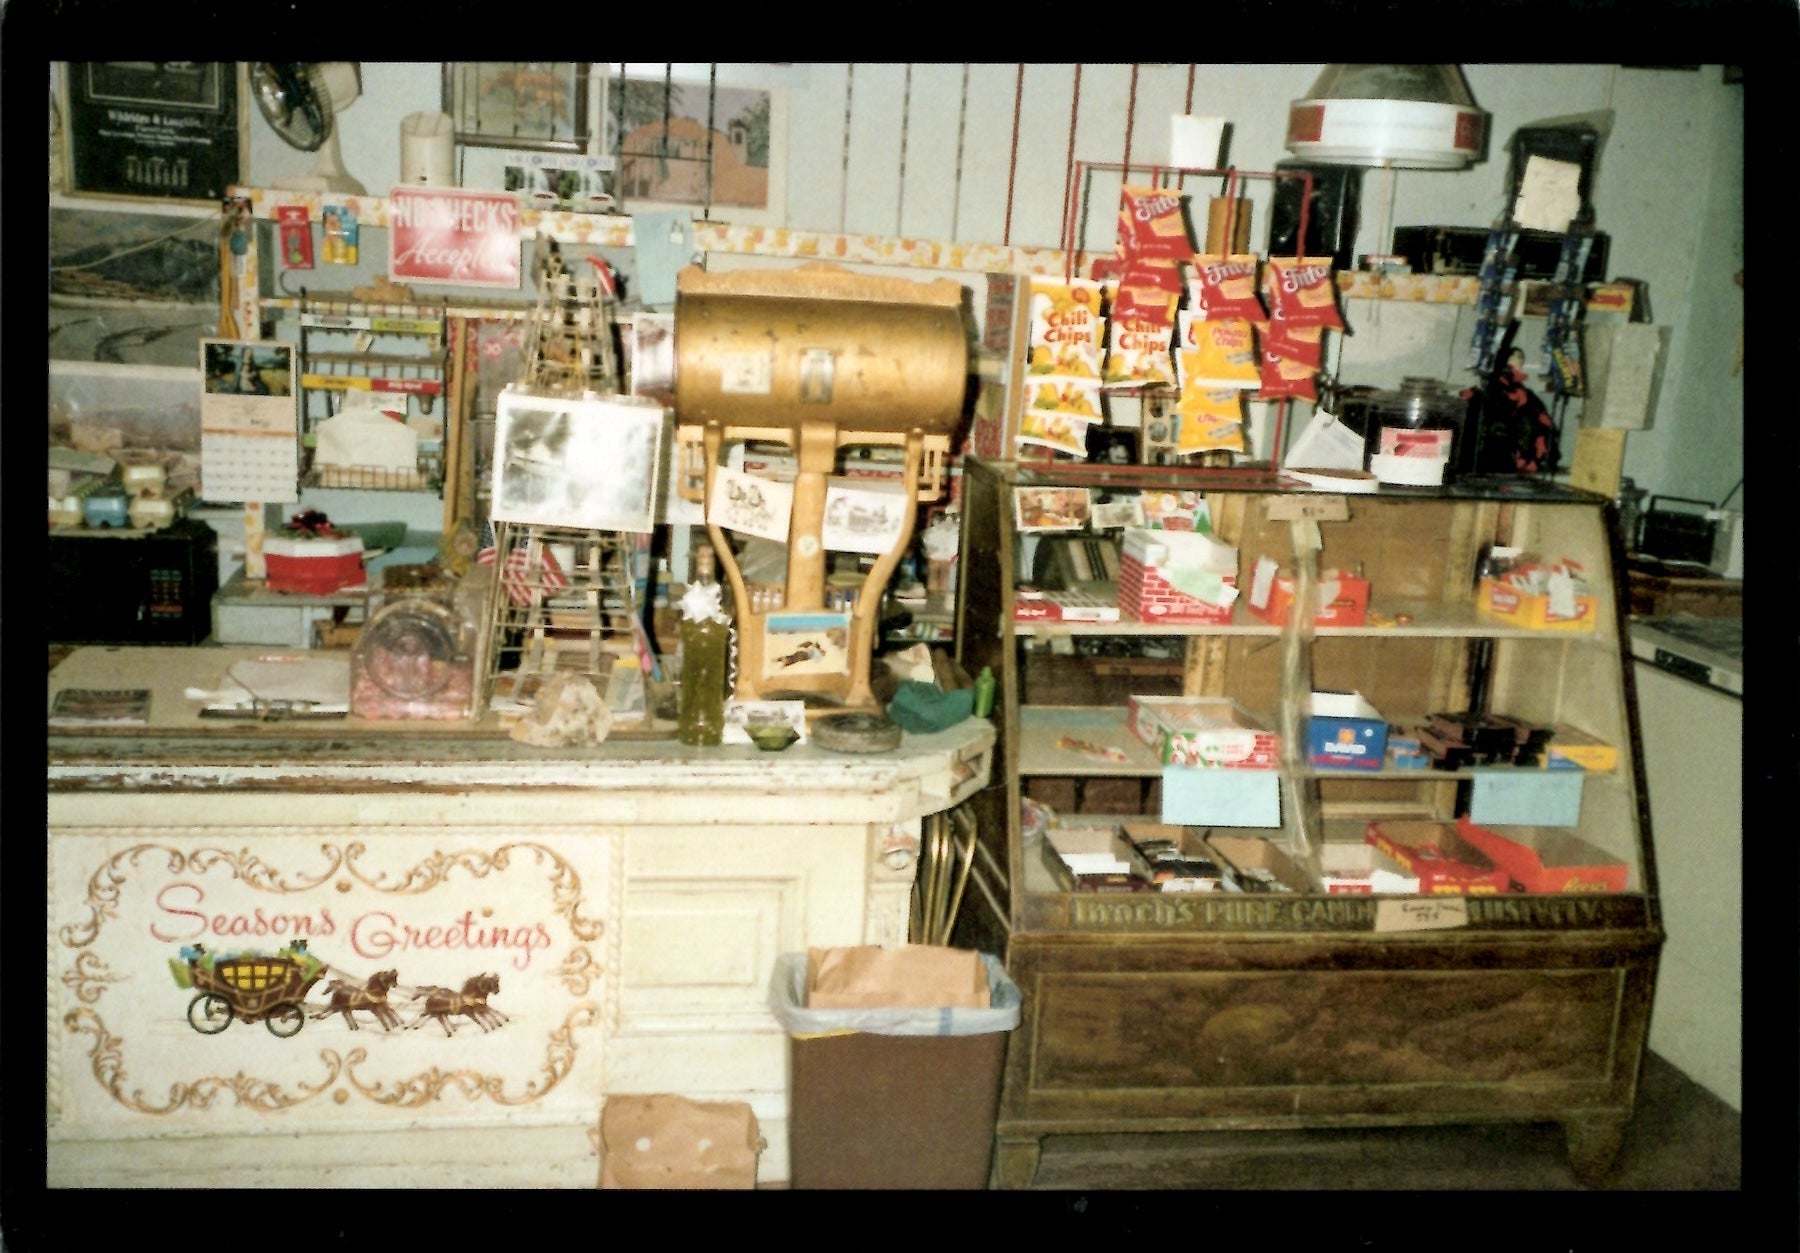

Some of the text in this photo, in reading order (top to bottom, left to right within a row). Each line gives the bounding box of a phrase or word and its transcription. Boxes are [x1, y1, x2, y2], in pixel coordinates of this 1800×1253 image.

[1134, 195, 1179, 222] Frito
[394, 231, 517, 280] Accept
[1281, 265, 1329, 293] Frito
[1047, 310, 1088, 328] Chili
[1044, 328, 1091, 345] Chips
[1119, 333, 1166, 355] Chips
[151, 882, 552, 970] Seasons Greetings
